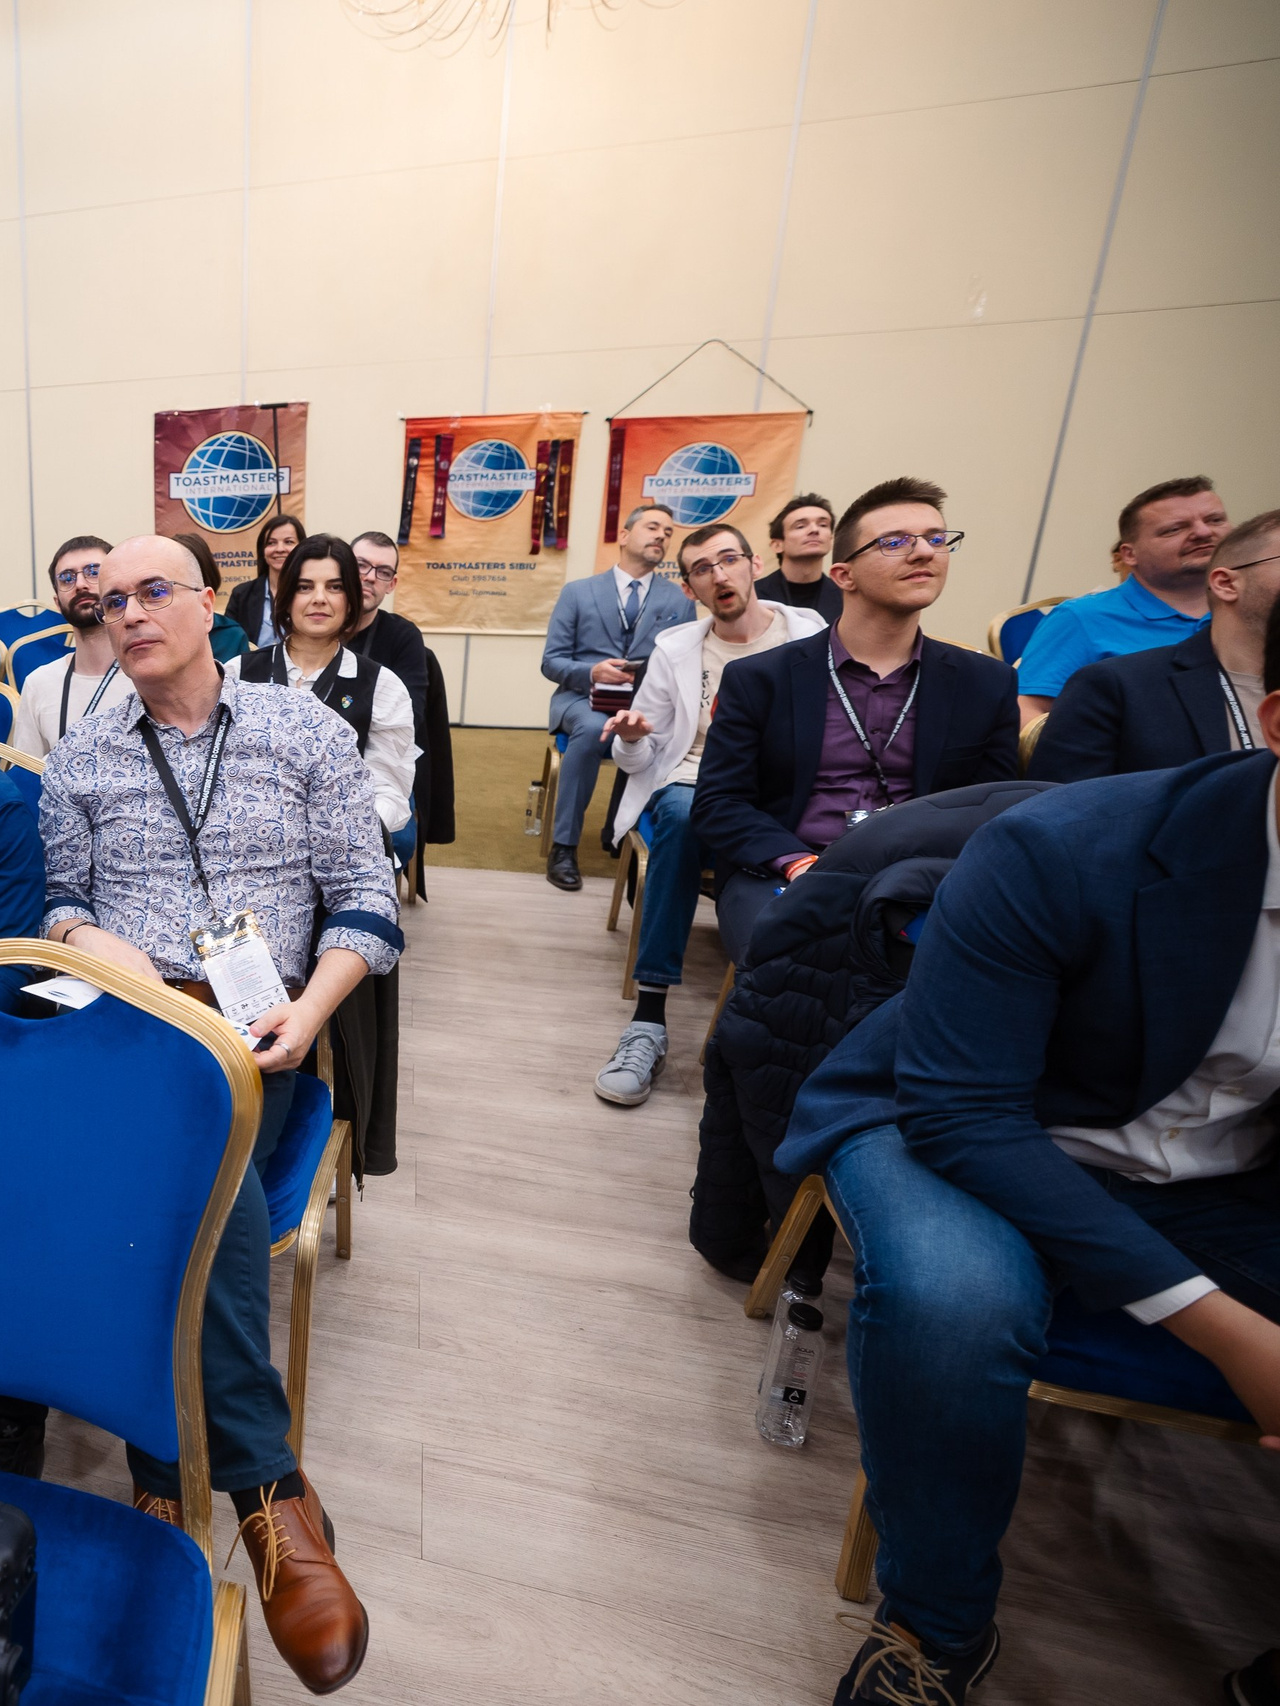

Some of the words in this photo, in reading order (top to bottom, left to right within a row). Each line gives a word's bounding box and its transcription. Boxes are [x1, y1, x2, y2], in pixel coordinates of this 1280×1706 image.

[174, 472, 285, 487] TOASTMASTERS
[449, 472, 536, 482] OASTMASTERS
[648, 476, 752, 487] TOASTMASTERS
[185, 484, 273, 495] INTERNATIONAL
[212, 551, 254, 559] MISOARA
[426, 562, 506, 570] TOASTMASTERS
[509, 562, 537, 570] SIBIU
[198, 779, 211, 815] TOASTMASTERS
[206, 758, 216, 778] DIVISION
[212, 724, 225, 754] CONFERENCE
